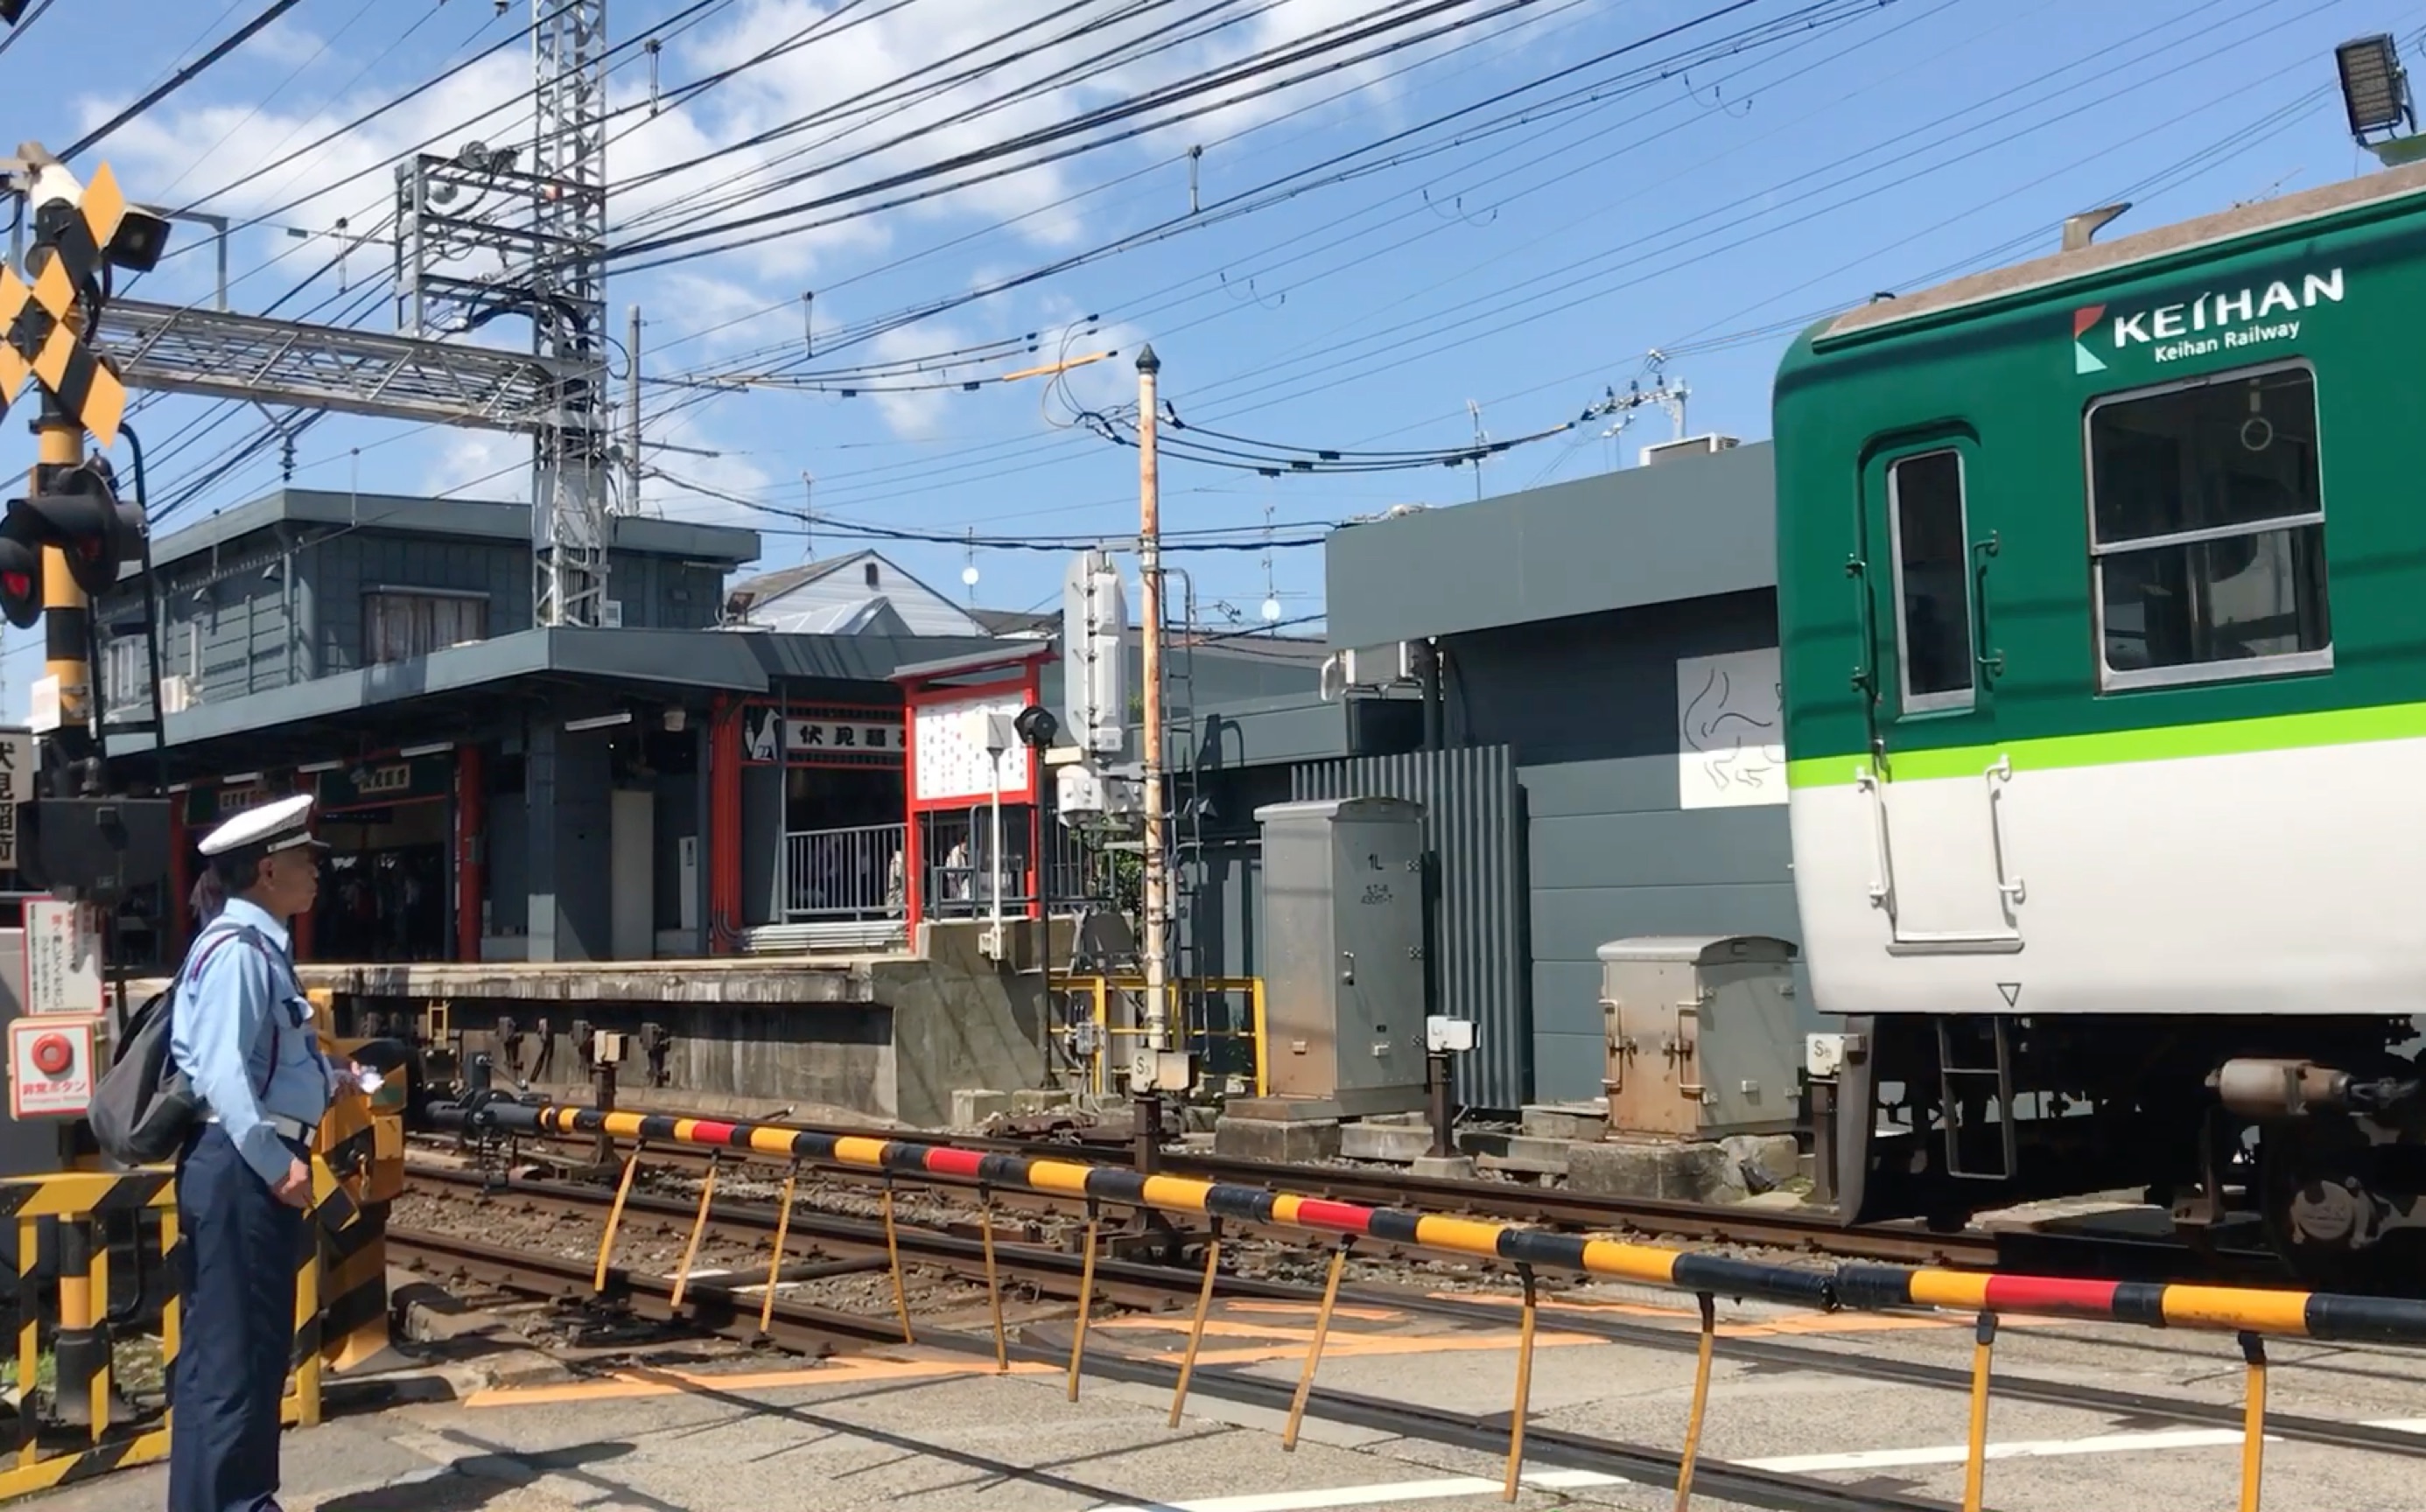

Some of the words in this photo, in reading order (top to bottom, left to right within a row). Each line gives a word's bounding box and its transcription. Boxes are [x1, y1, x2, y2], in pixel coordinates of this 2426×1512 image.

[2114, 268, 2344, 347] KEIHAN
[2155, 338, 2218, 362] Keihan
[2225, 320, 2300, 349] Railway
